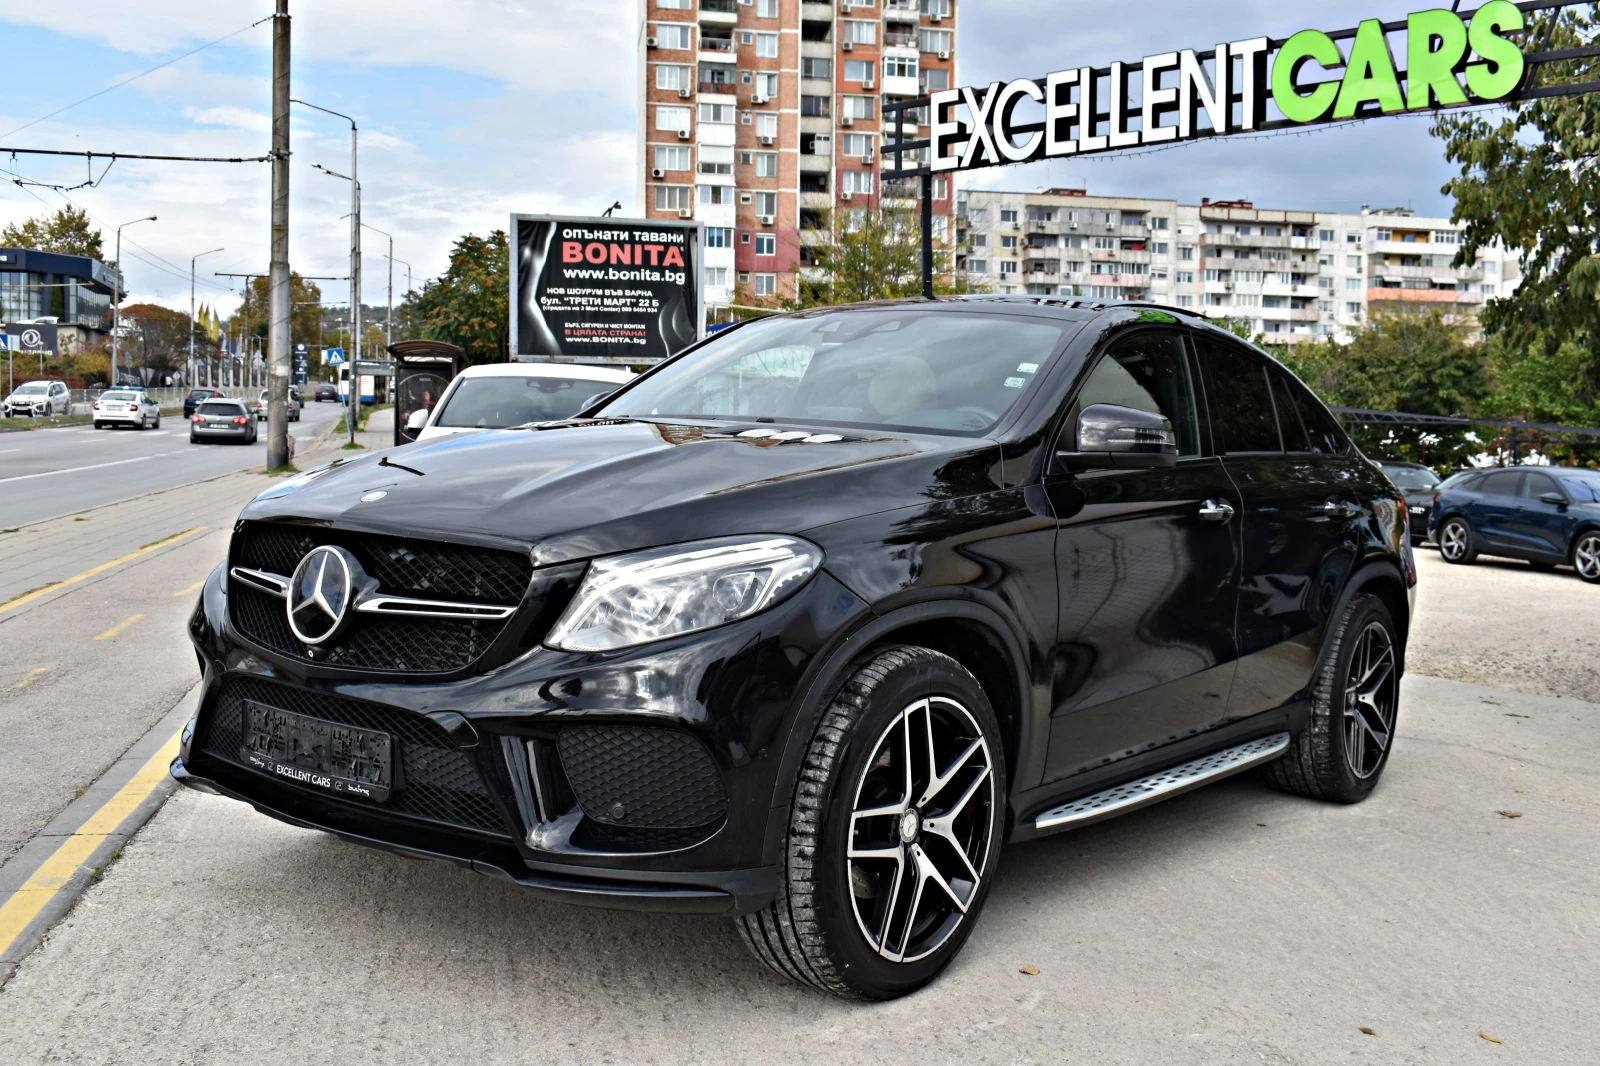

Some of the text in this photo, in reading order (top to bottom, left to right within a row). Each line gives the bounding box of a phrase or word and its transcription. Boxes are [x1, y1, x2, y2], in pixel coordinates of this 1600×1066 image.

[930, 0, 1525, 172] EXCELLENT CARS
[562, 229, 684, 243] опънати тавани
[562, 241, 685, 267] BONITA
[563, 268, 685, 285] www.bonita.bg
[567, 288, 603, 296] ШОУРУМ
[540, 297, 562, 305] бул.
[276, 764, 330, 788] EXCELLENT CARS
